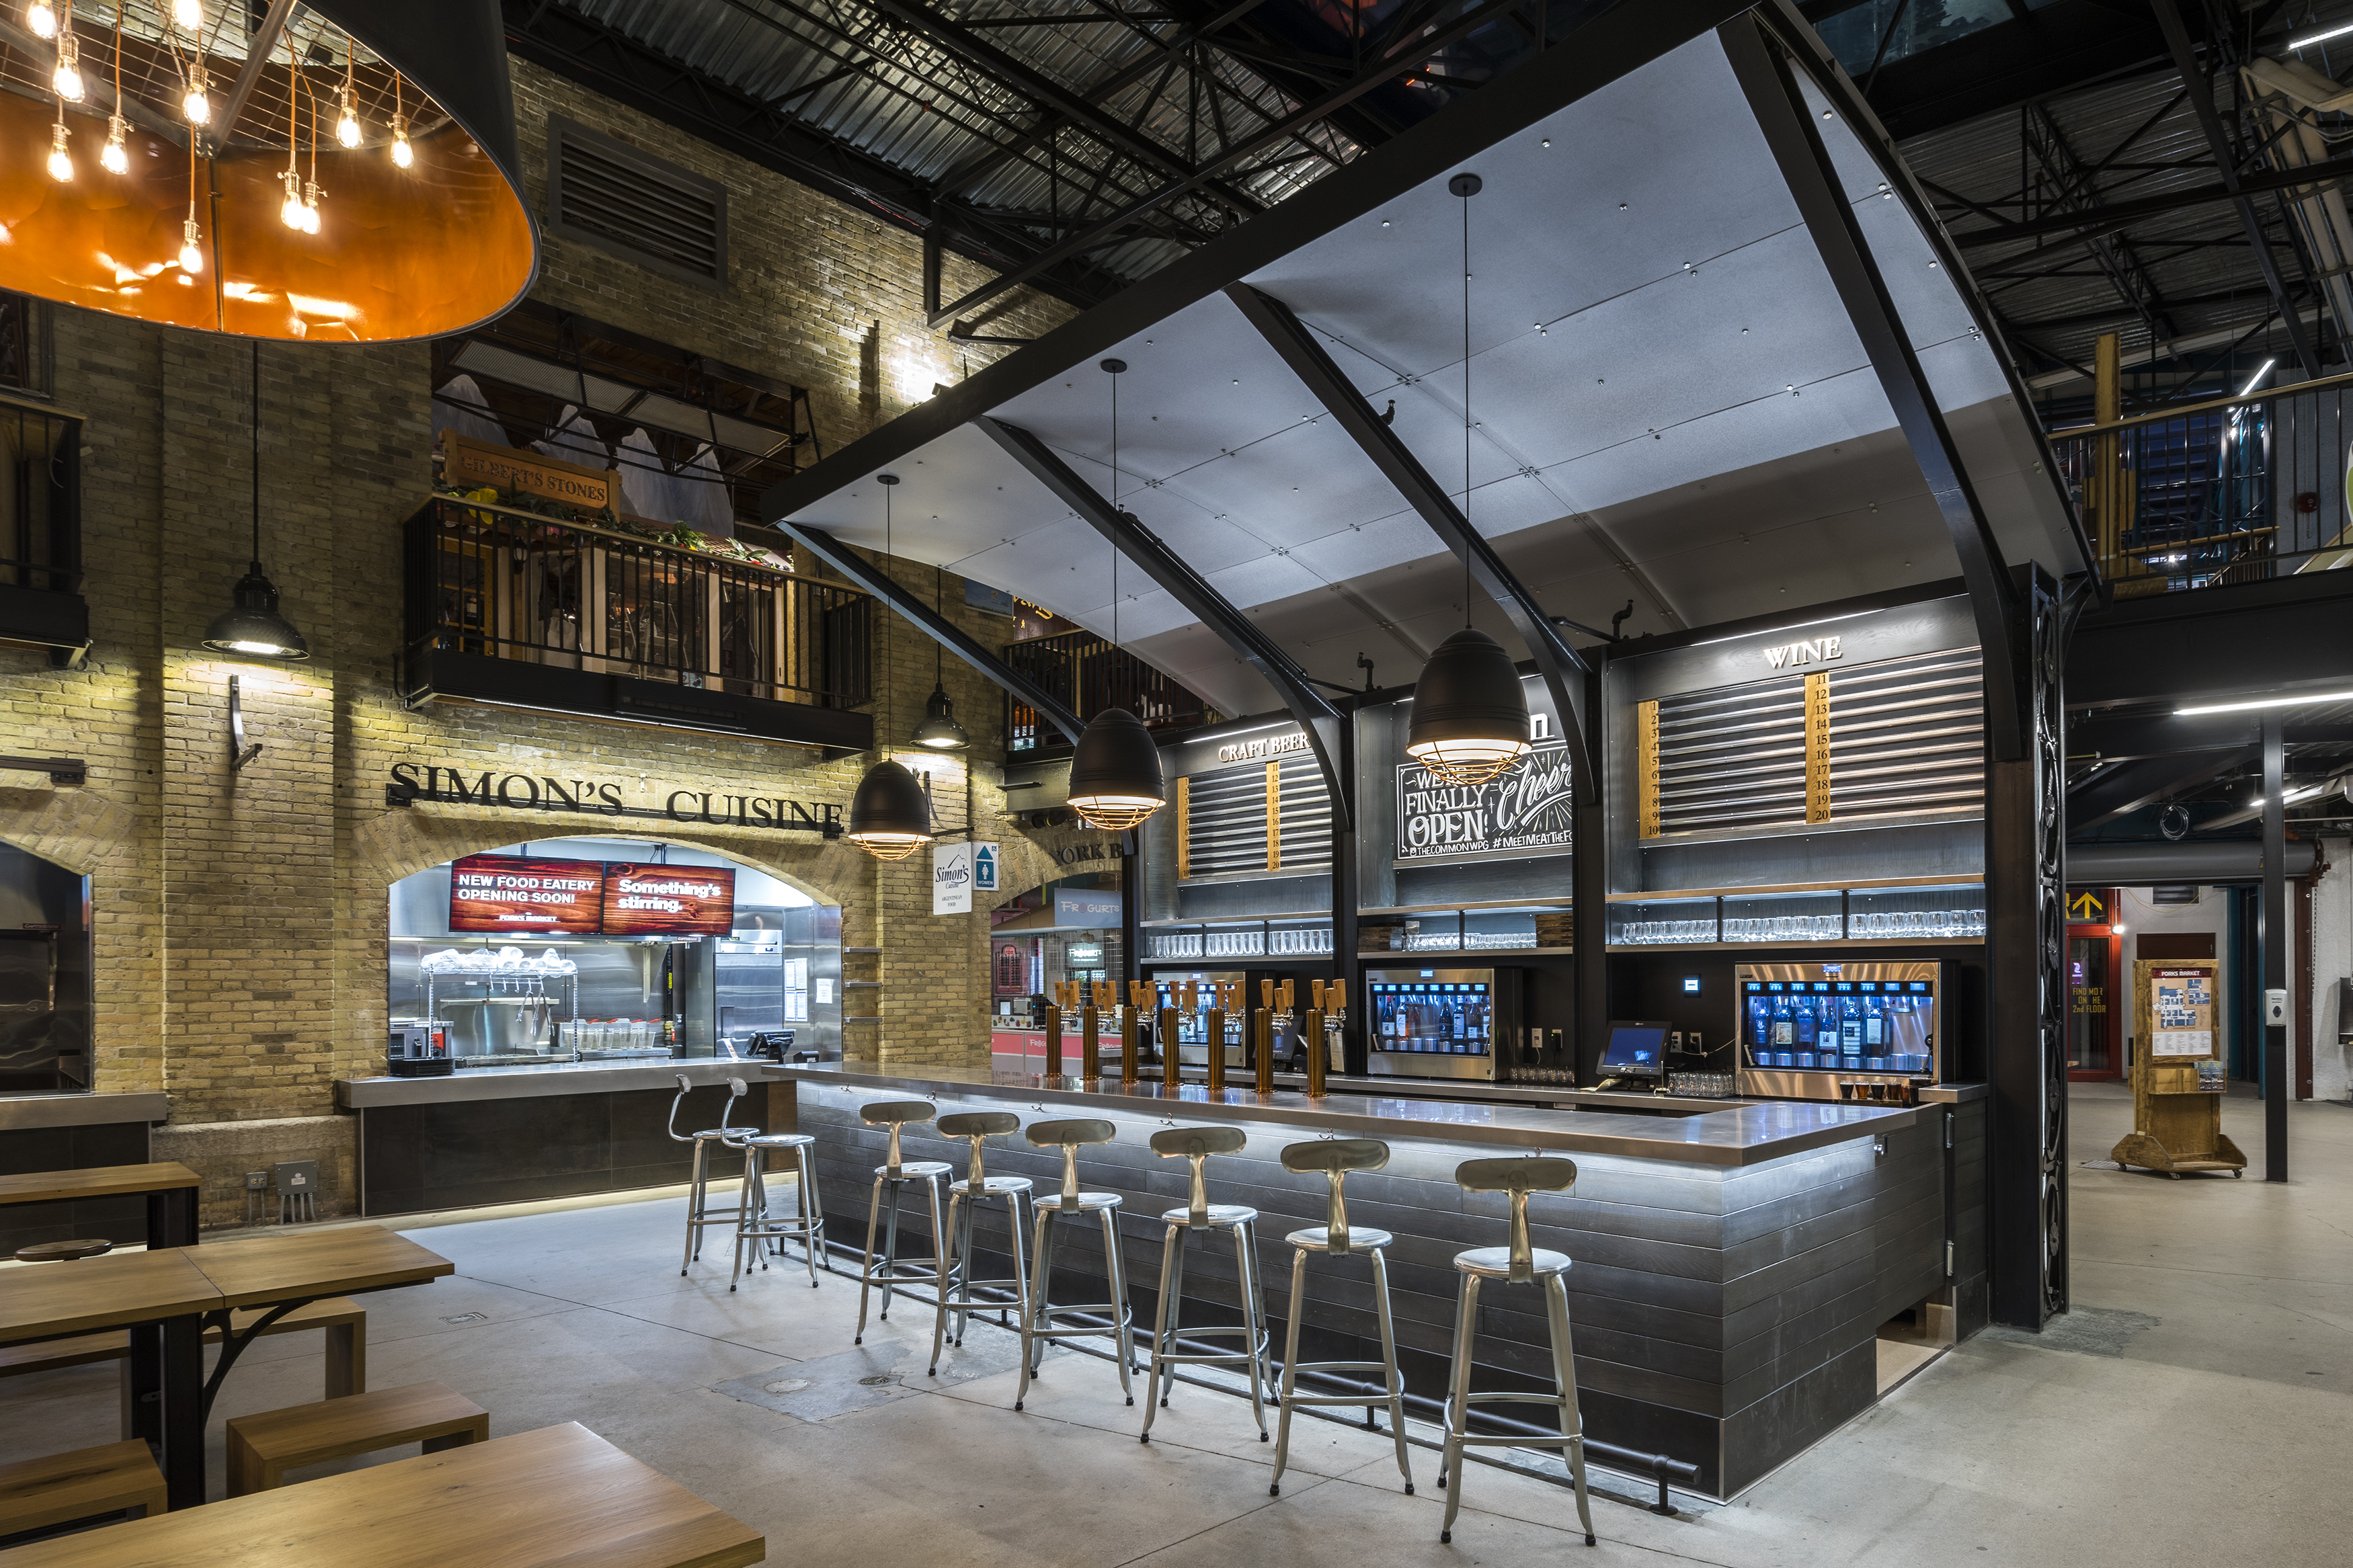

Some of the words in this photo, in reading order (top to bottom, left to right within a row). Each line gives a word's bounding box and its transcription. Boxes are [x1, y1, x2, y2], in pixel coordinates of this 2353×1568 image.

[461, 455, 543, 487] GILBERT'S
[547, 476, 605, 501] STONES
[1763, 636, 1842, 669] WINE
[1816, 674, 1826, 685] 11
[1815, 690, 1827, 700] 12
[1652, 702, 1656, 710] 1
[1815, 704, 1827, 714] 13
[1651, 716, 1657, 725] 2
[1815, 719, 1827, 730] 14
[1651, 729, 1657, 738] 3
[1816, 734, 1827, 745] 15
[1218, 739, 1268, 762] CRAFT
[1271, 732, 1311, 753] BEER
[1651, 743, 1657, 751] 4
[1816, 749, 1827, 759] 16
[1652, 757, 1657, 766] 5
[1652, 770, 1657, 779] 6
[1816, 765, 1827, 775] 17
[1652, 784, 1657, 793] 7
[1817, 780, 1828, 790] 18
[391, 762, 623, 816] SIMON'S
[666, 790, 844, 833] CUISINE
[1406, 783, 1488, 815] FINALLY
[1497, 760, 1572, 830] Cheer
[1817, 794, 1828, 805] 19
[1652, 798, 1657, 807] 8
[1652, 812, 1658, 821] 9
[1815, 810, 1828, 820] 20
[1273, 829, 1279, 837] 17
[1408, 809, 1488, 847] OPEN!
[1648, 825, 1658, 835] 10
[1051, 843, 1106, 866] YORK
[1273, 850, 1279, 858] 19
[936, 864, 969, 884] Simon's
[458, 874, 493, 886] NEW
[497, 876, 539, 888] FOOD
[543, 879, 595, 891] EATERY
[619, 879, 721, 898] Something's
[458, 889, 528, 902] OPENING
[532, 893, 575, 903] SOON!
[618, 896, 682, 913] stirring.
[2073, 987, 2087, 995] FIND
[2078, 996, 2087, 1004] ON
[2092, 996, 2100, 1004] HE
[2073, 1005, 2084, 1013] 2nd
[2086, 1005, 2106, 1013] FLOOR
